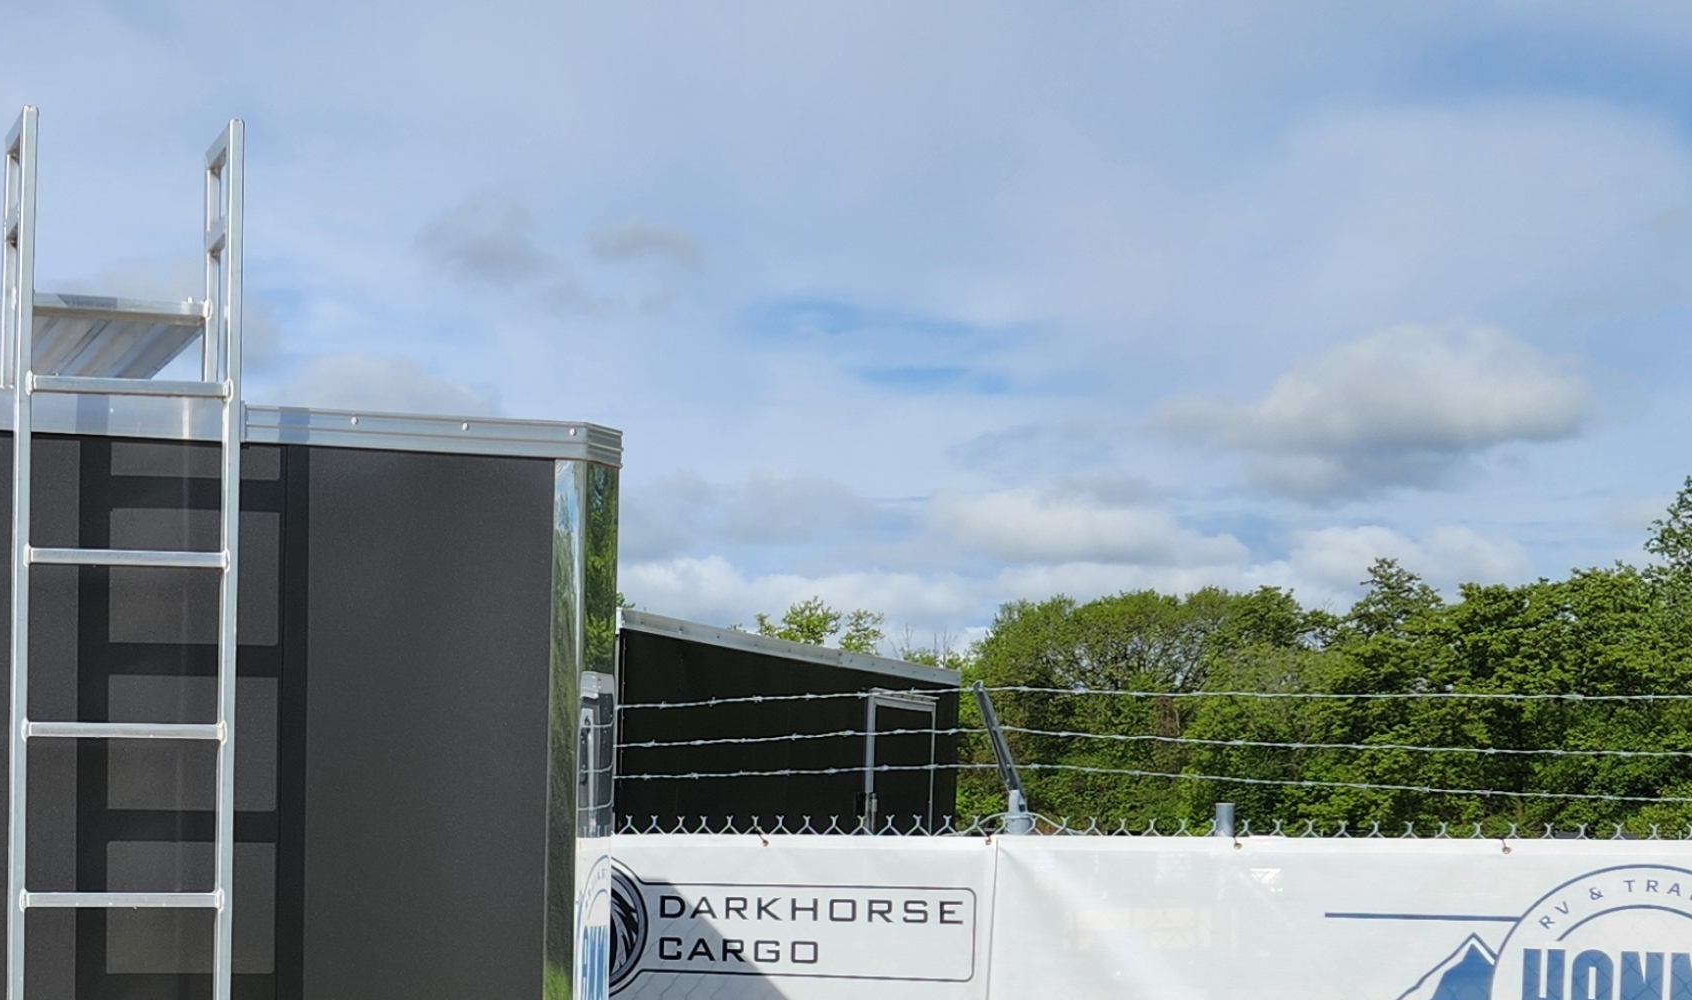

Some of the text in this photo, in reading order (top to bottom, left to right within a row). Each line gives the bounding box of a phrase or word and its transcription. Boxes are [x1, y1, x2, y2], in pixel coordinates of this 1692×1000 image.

[659, 895, 964, 925] DARKHORSE
[1538, 879, 1692, 929] RV & TRA
[658, 937, 819, 964] CARGO
